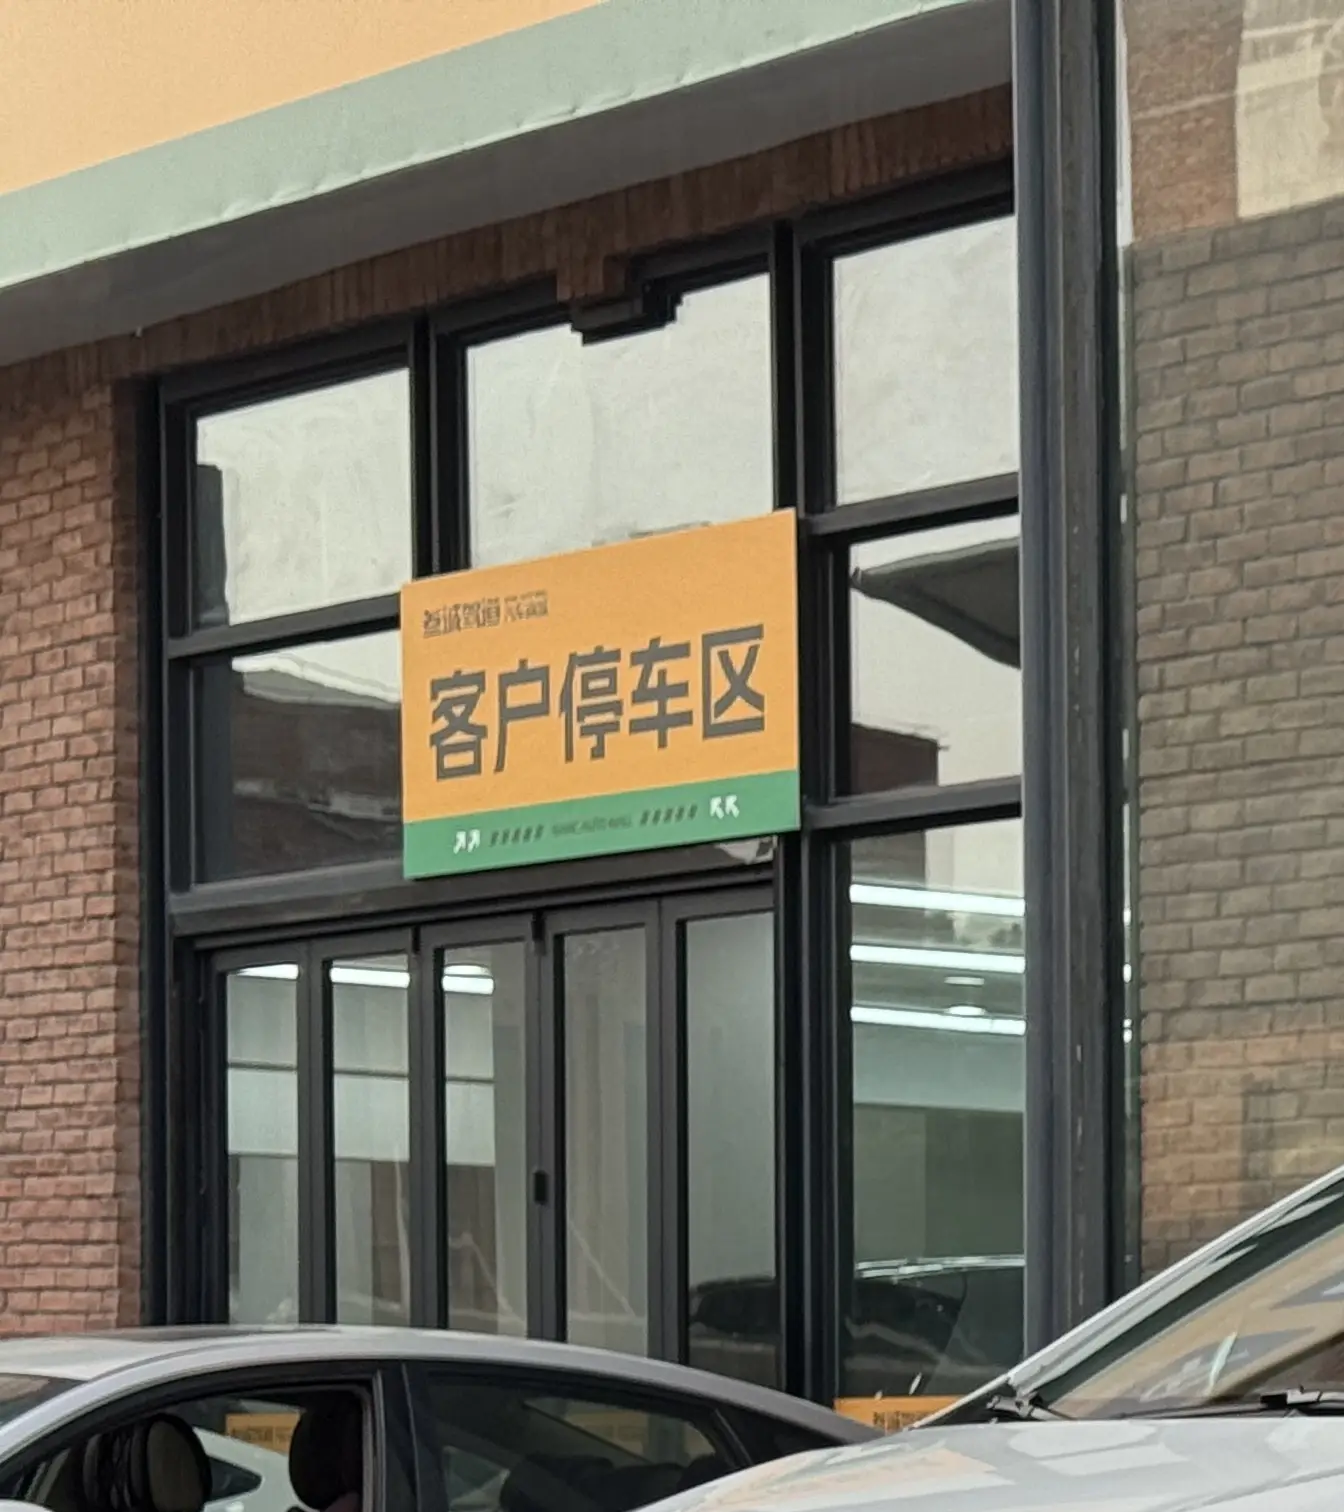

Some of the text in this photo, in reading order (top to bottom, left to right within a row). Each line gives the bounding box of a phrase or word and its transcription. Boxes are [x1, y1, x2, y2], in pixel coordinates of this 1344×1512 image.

[429, 623, 765, 783] 客户停车区
